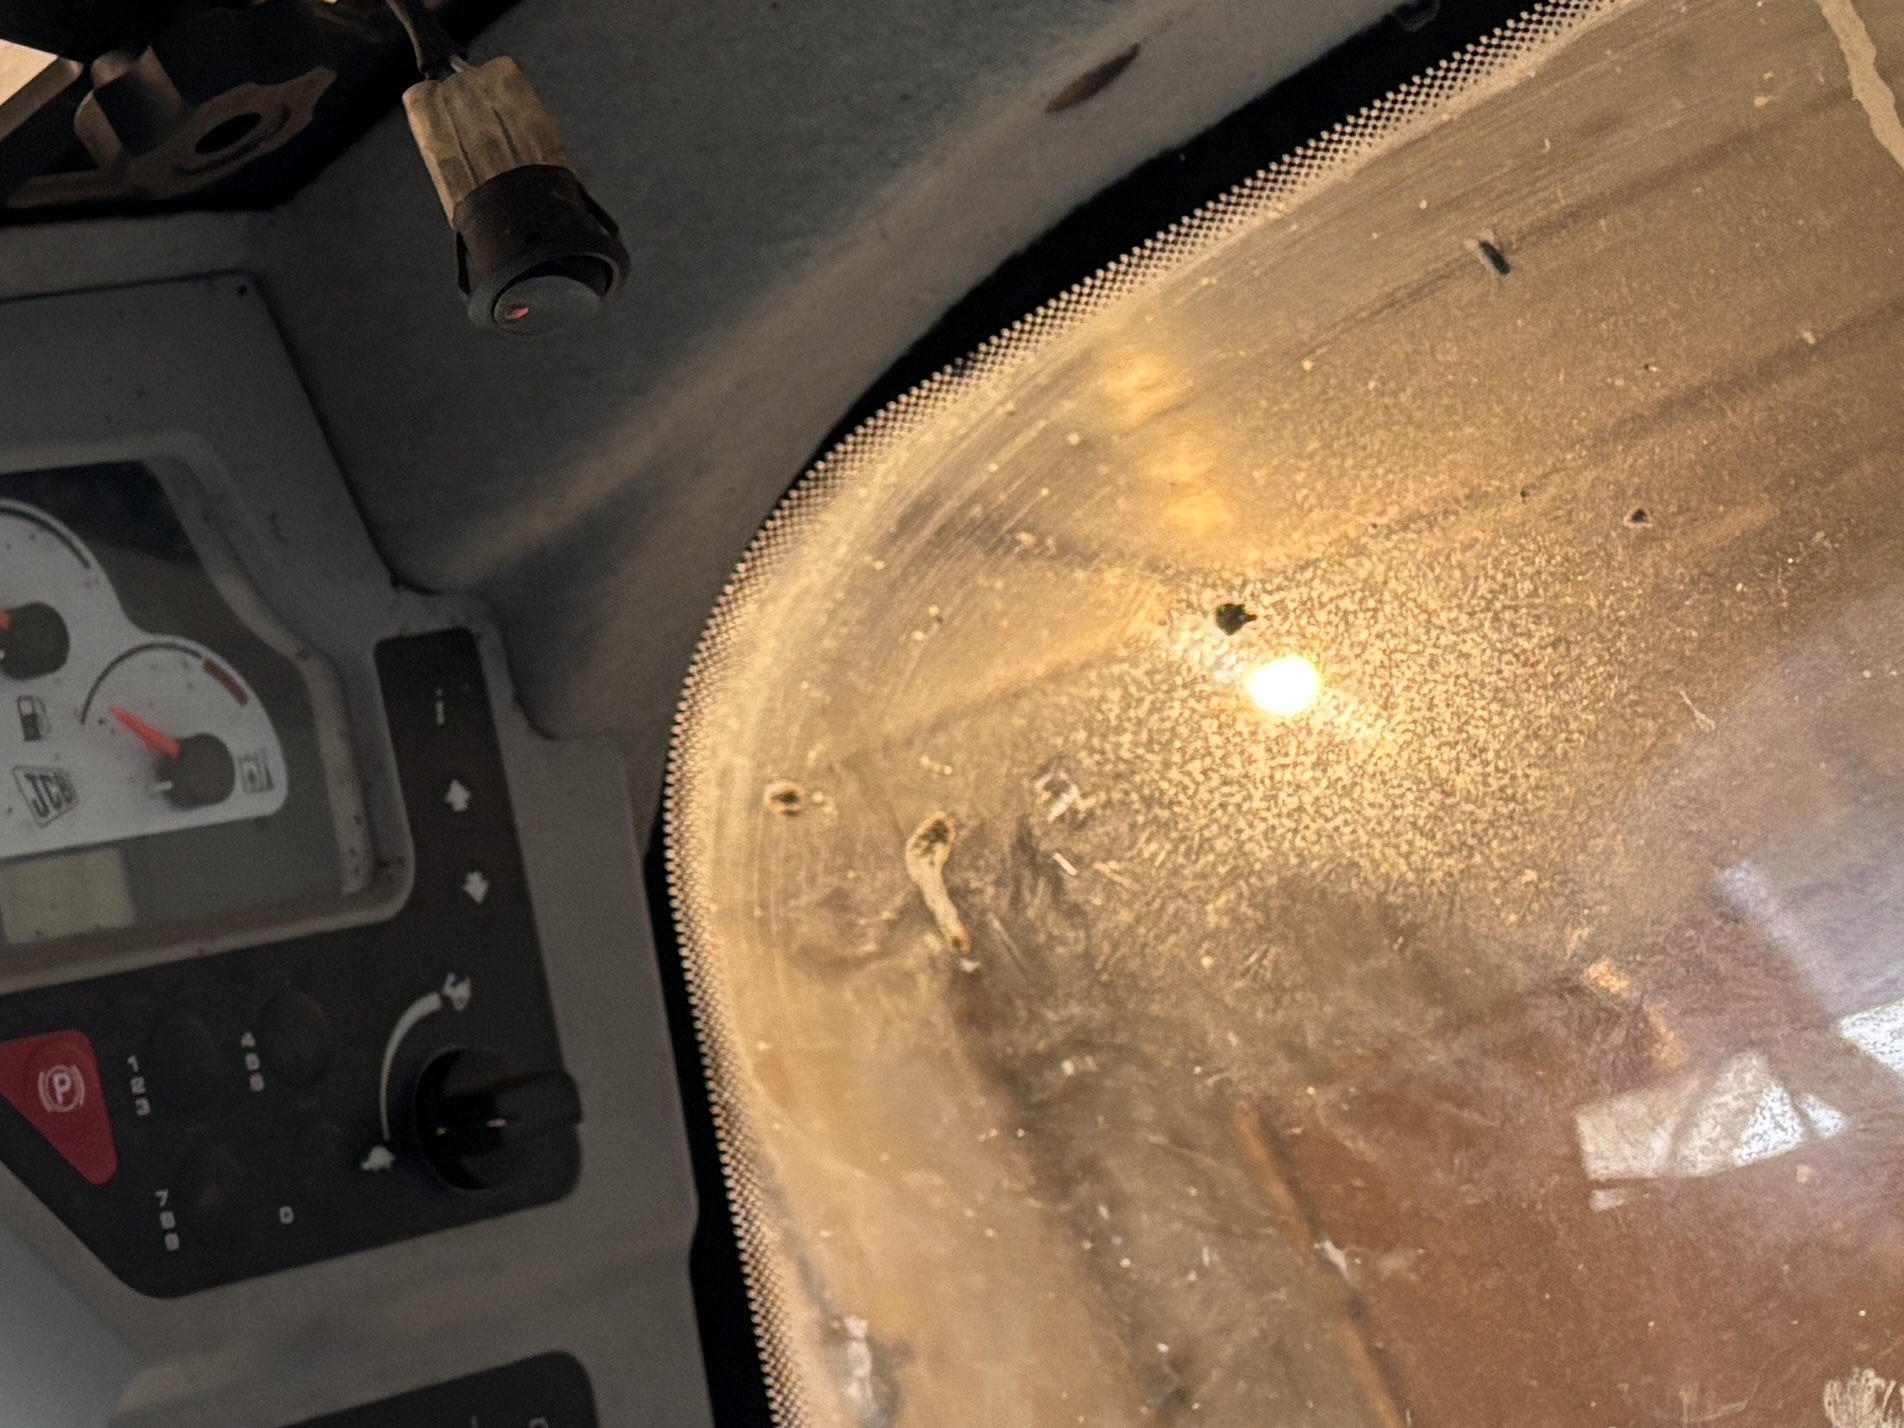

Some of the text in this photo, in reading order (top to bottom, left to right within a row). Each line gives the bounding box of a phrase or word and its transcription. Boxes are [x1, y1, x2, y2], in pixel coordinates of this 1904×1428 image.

[24, 770, 74, 818] JCB
[241, 1031, 256, 1047] 4
[127, 1055, 139, 1071] 1
[52, 1072, 72, 1105] P
[130, 1076, 146, 1095] 2
[135, 1097, 151, 1116] 3
[155, 1188, 168, 1207] 7
